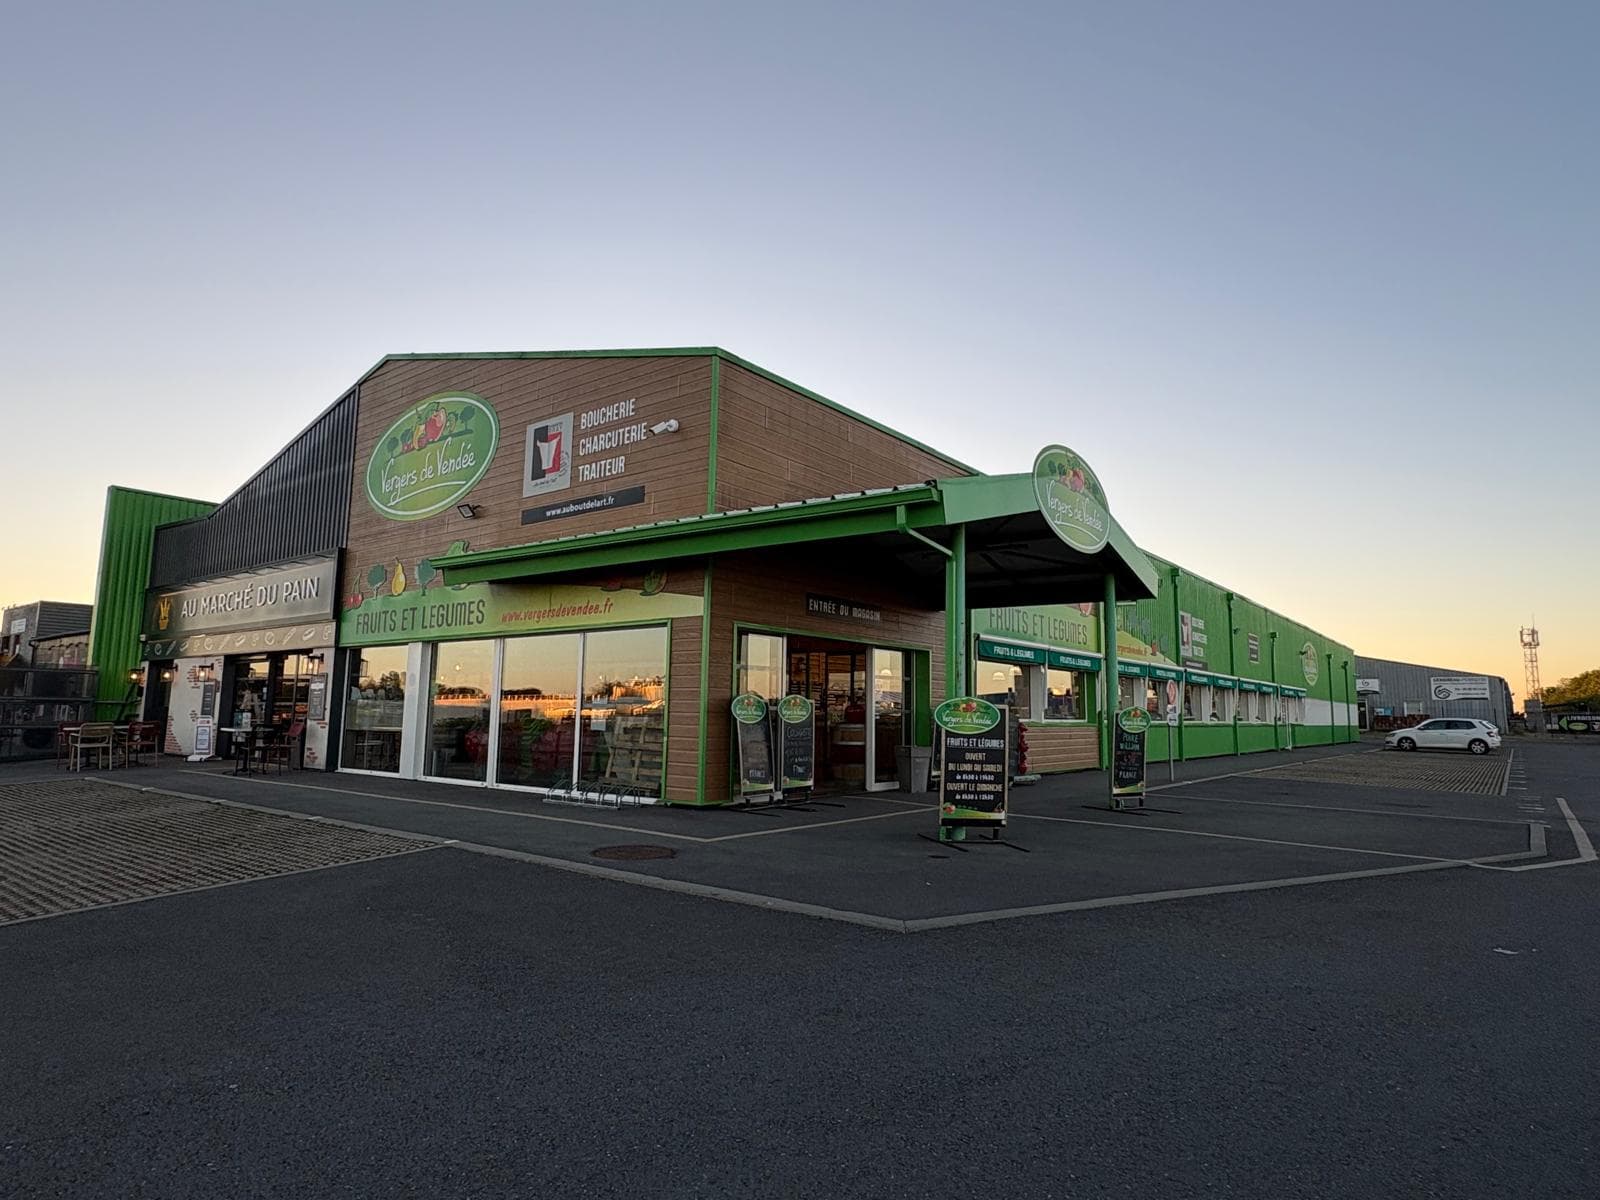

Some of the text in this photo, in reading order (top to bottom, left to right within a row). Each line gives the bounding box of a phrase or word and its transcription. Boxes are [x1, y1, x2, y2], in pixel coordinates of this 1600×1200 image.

[580, 398, 636, 430] BOUCHERIE
[579, 422, 648, 456] CHARCUTERIE
[381, 436, 476, 503] Vergers de Vendée
[578, 455, 626, 482] TRAITEUR
[545, 496, 615, 517] www.auboutdelart.fr
[181, 576, 320, 618] AU MARCHÉ DU PAIN
[501, 597, 614, 624] www.vergersdevendee.fr
[808, 598, 881, 621] ENTRÉE DU MAGASIN
[356, 599, 486, 635] FRUITS ET LEGUMES
[989, 608, 1088, 645] FRUITS ET LEGUMES
[946, 737, 968, 747] FRUITS
[969, 738, 976, 747] ET
[965, 752, 986, 761] OUVERT
[974, 763, 981, 772] AU
[946, 782, 968, 791] OUVERT
[968, 783, 976, 791] LE
